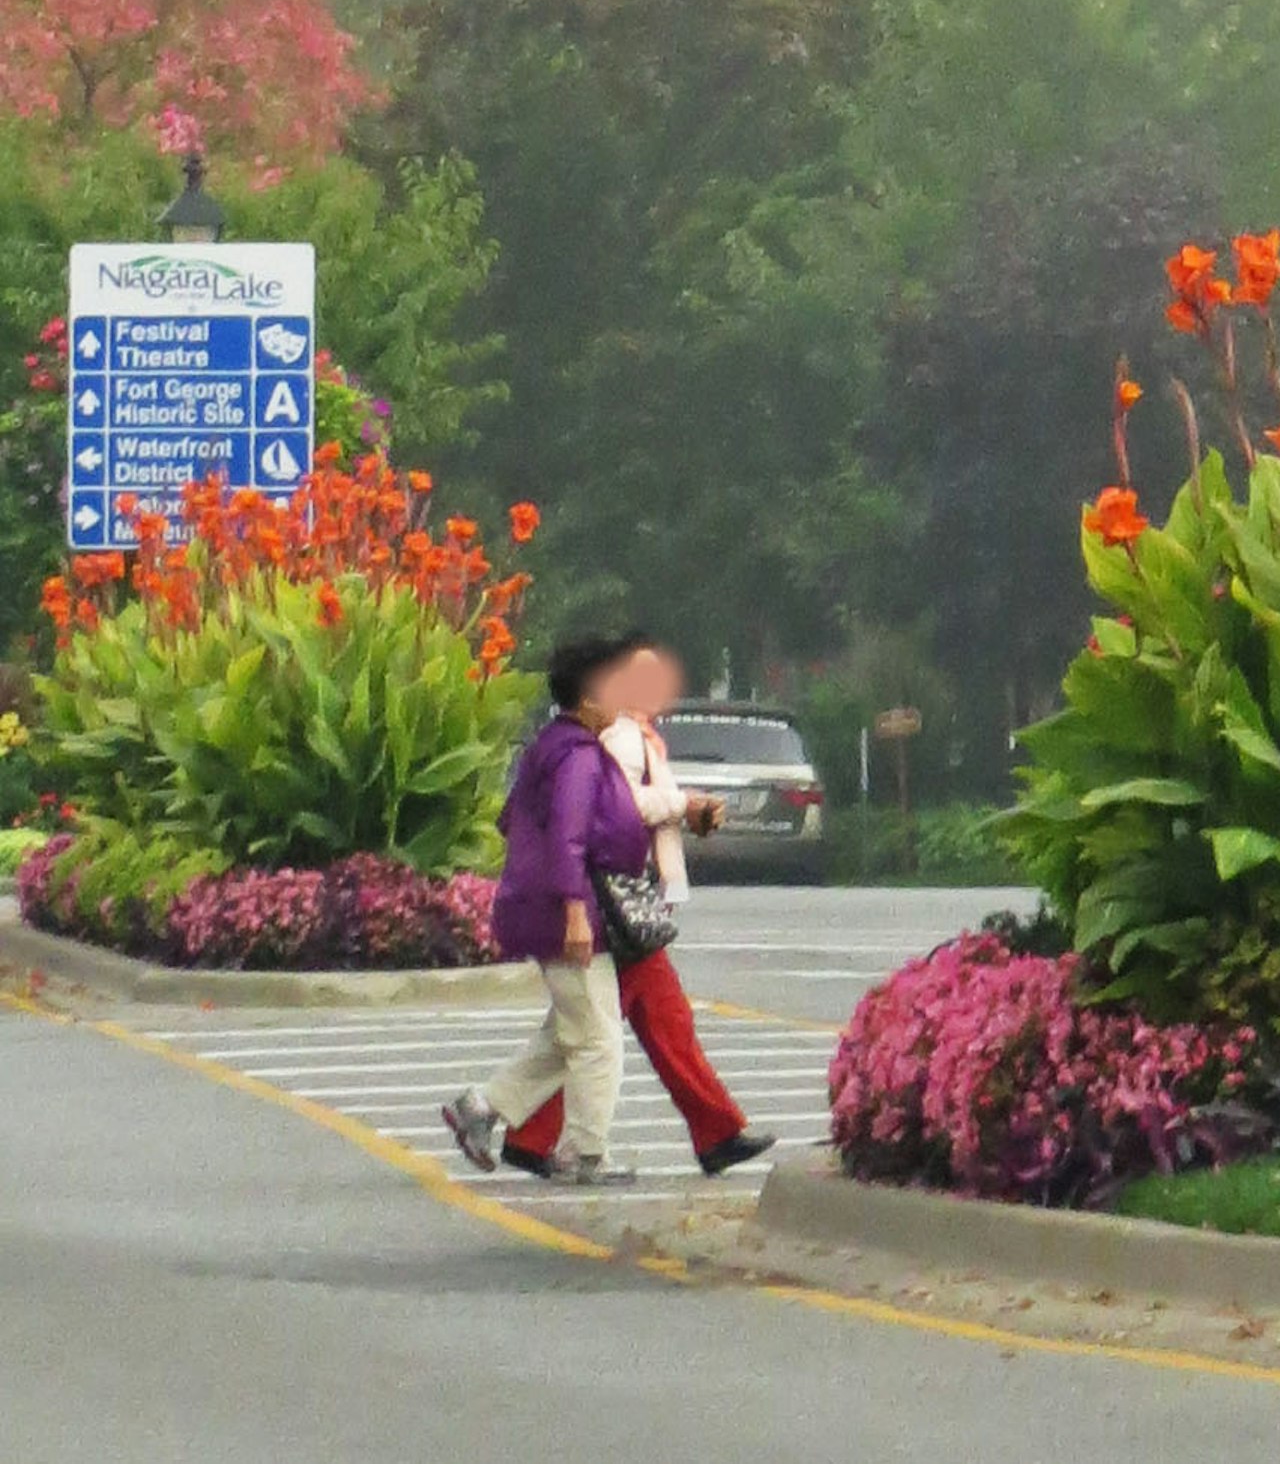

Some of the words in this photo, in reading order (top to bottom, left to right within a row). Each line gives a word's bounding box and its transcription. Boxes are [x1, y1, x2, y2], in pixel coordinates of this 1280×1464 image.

[98, 261, 211, 298] Niagara
[212, 272, 284, 301] Lake
[116, 320, 210, 342] Festival
[116, 346, 210, 367] Theatre
[115, 378, 158, 400] Fort
[164, 377, 242, 406] George
[114, 404, 199, 425] Historic
[203, 402, 245, 425] Site
[115, 436, 234, 458] Waterfront
[114, 461, 194, 482] District
